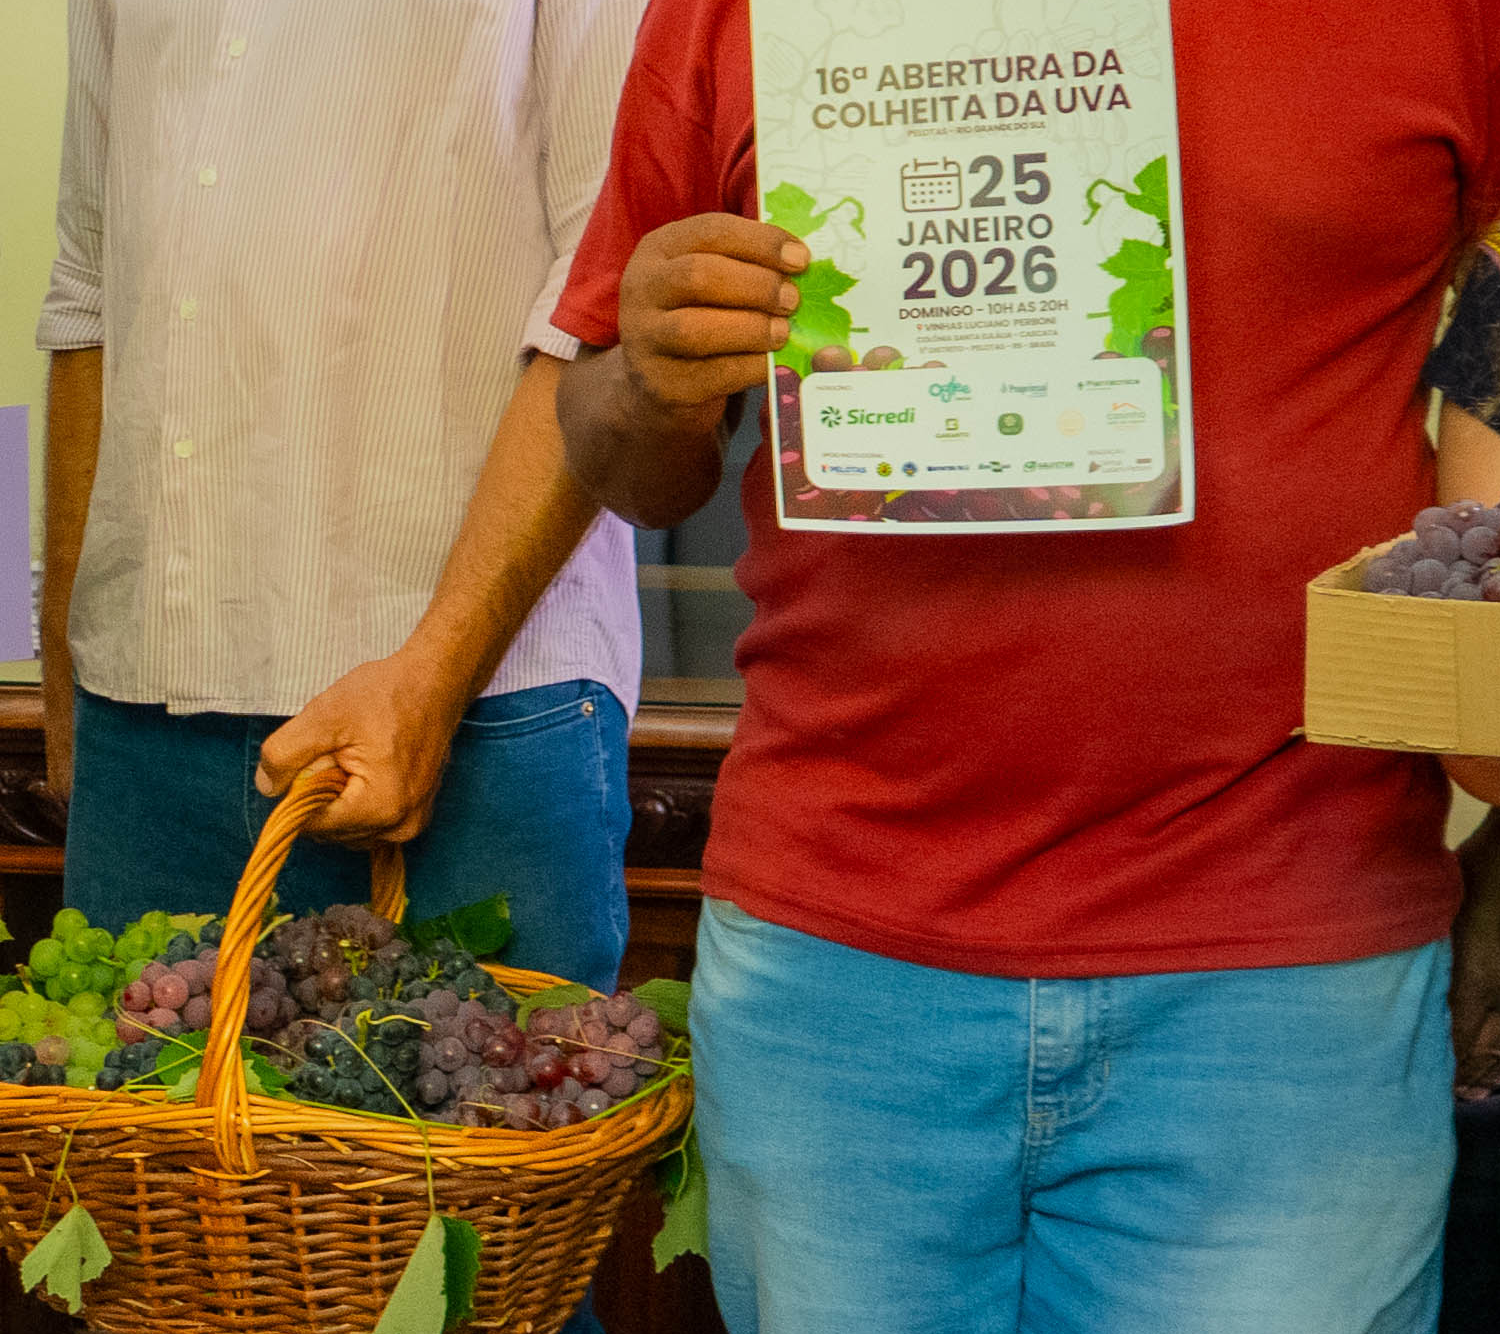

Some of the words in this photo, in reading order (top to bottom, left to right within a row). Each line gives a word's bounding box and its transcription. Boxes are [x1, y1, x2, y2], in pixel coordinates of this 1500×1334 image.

[815, 66, 868, 96] 16ª
[875, 52, 1065, 92] ABERTURA
[1072, 48, 1125, 78] DA
[811, 93, 987, 130] COLHEITA
[995, 88, 1048, 119] DA
[1055, 83, 1133, 114] UVA
[968, 151, 1052, 209] 25
[897, 213, 1054, 247] JANEIRO
[902, 245, 1058, 300] 2026
[898, 305, 974, 320] DOMINGO
[987, 302, 1014, 316] 10H
[1039, 299, 1069, 312] 20H
[847, 407, 917, 425] Sicredi
